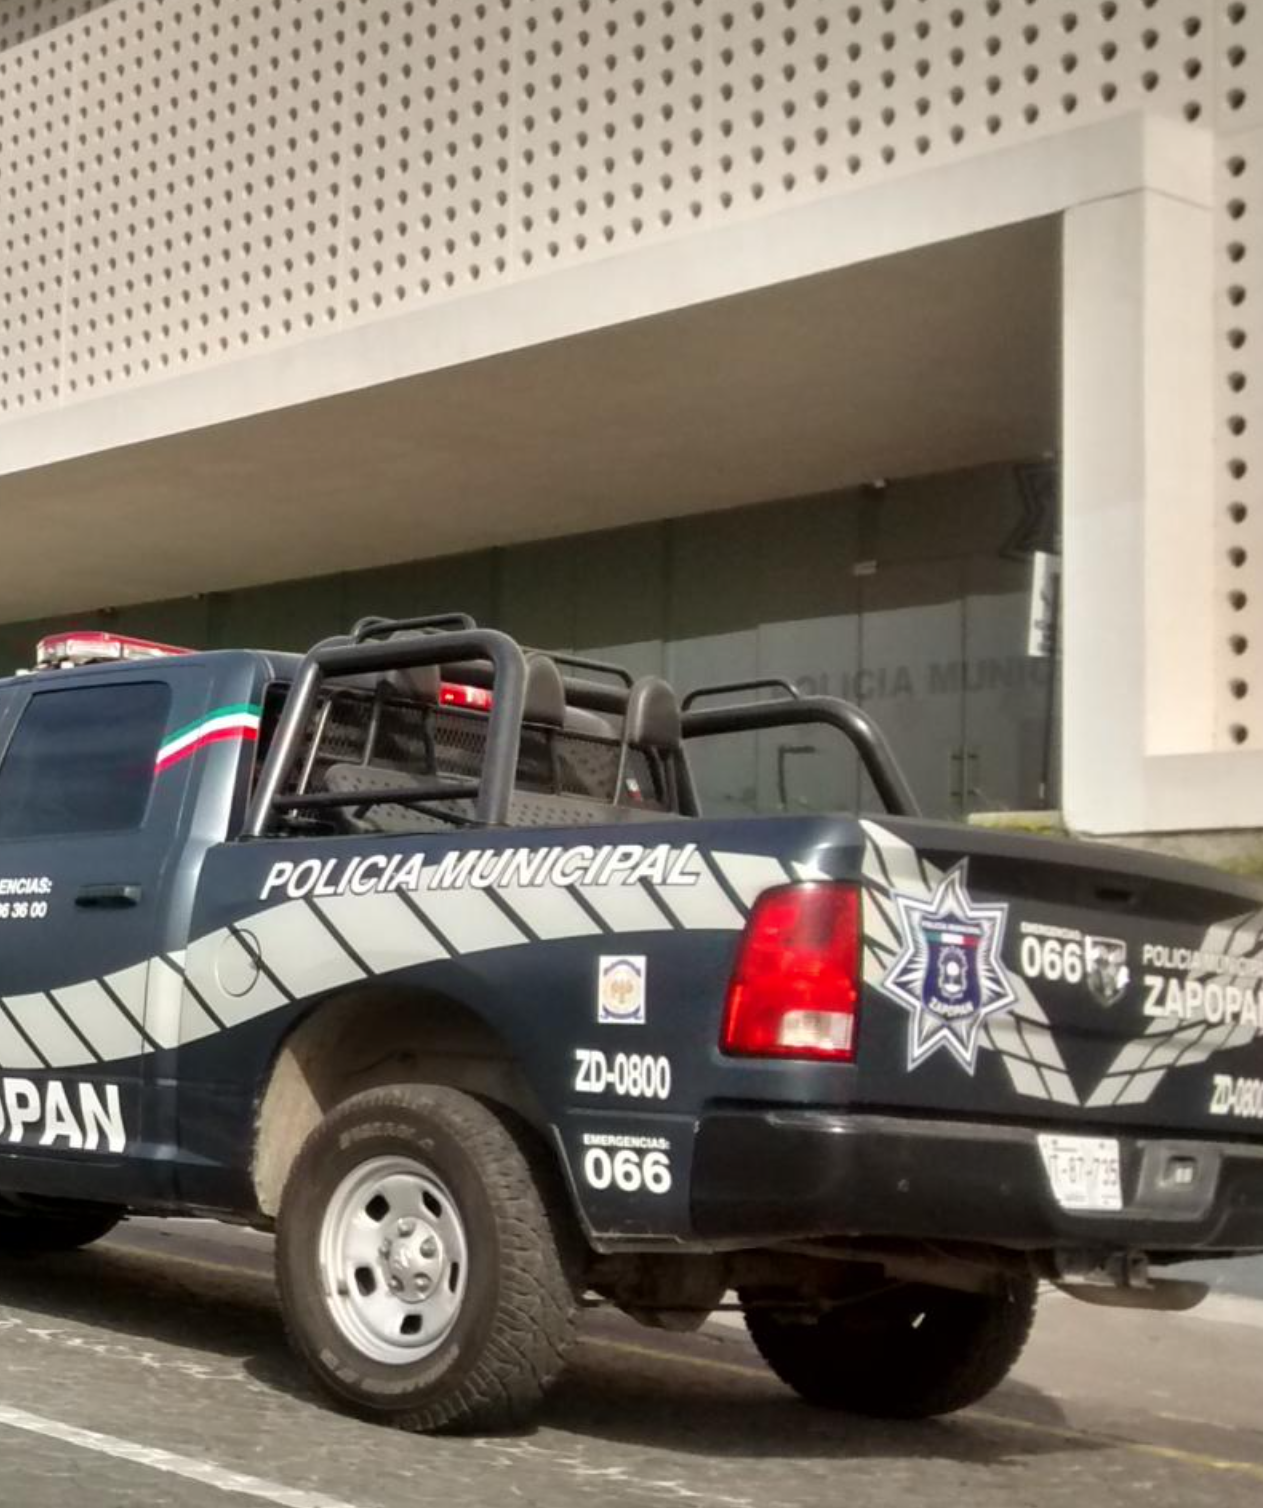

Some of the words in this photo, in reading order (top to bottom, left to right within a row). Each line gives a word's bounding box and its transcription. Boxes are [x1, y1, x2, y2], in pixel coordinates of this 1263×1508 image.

[260, 852, 425, 900] POLICIA
[430, 843, 703, 890] MUNICIPAL
[30, 901, 48, 918] 00
[1021, 936, 1083, 983] 066
[1142, 944, 1200, 971] POLICIA
[575, 1049, 671, 1100] ZD-0800
[583, 1133, 671, 1150] EMERGENCIAS:
[584, 1147, 673, 1194] 066
